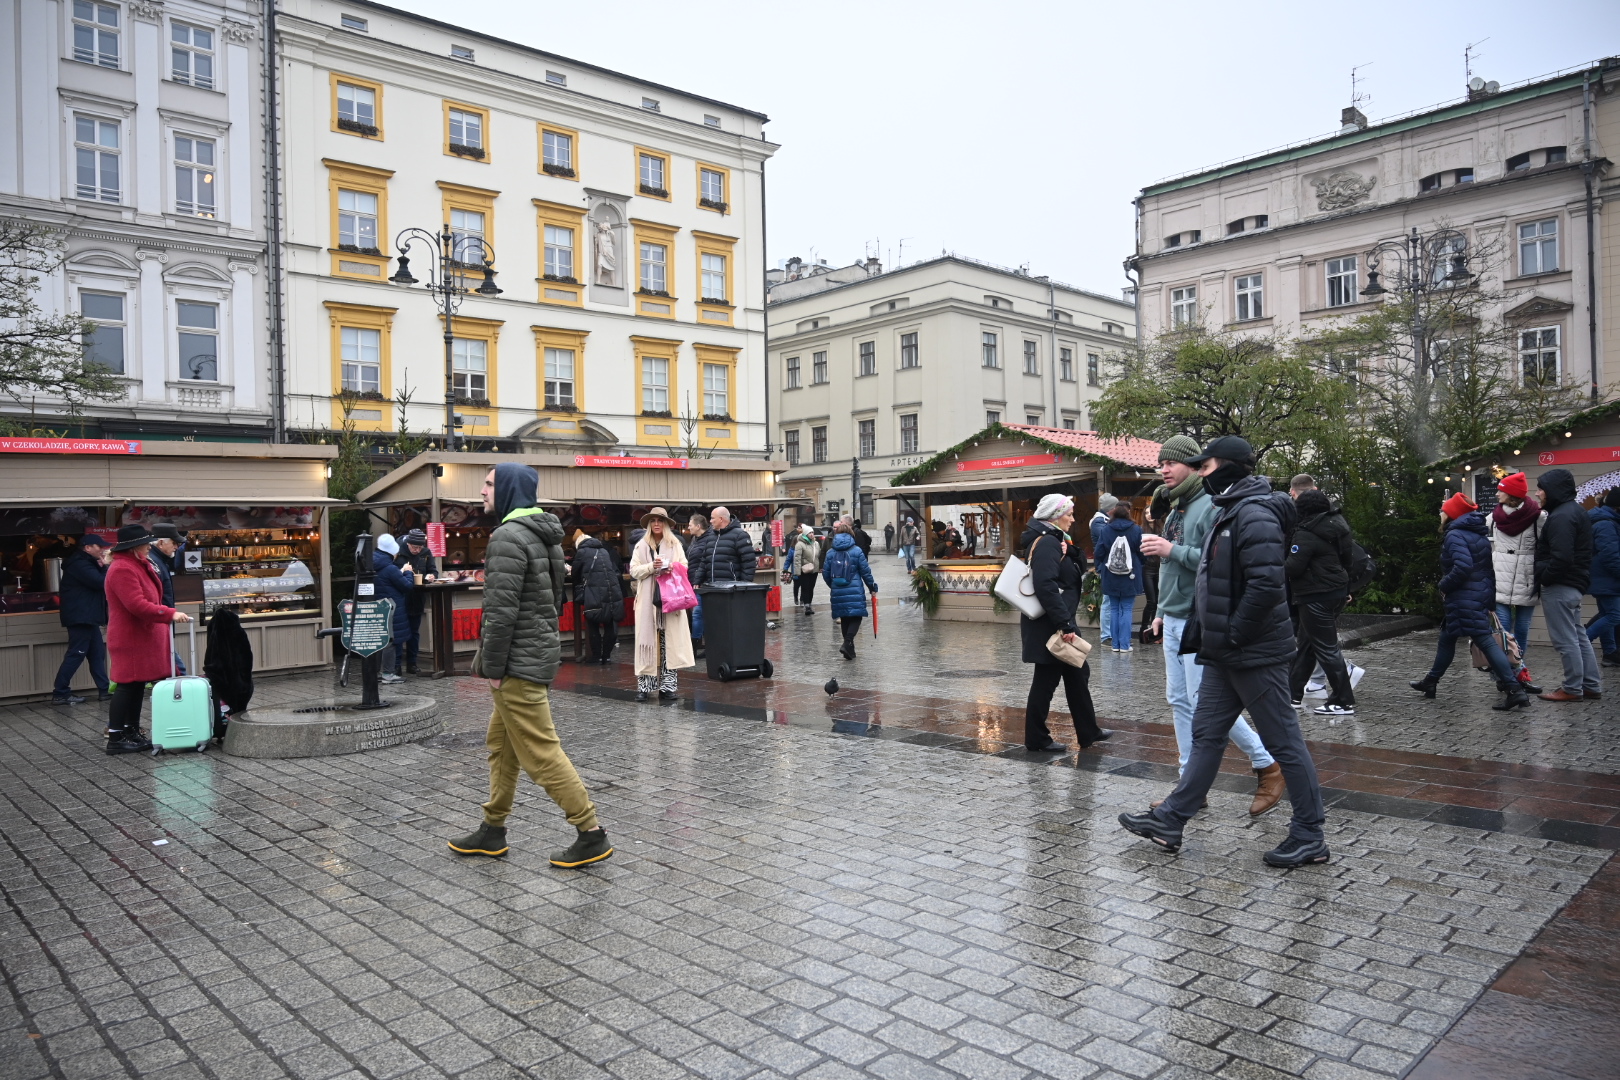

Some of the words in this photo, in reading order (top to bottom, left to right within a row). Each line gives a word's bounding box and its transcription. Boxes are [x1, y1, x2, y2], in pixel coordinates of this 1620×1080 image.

[890, 456, 924, 467] APTEKA
[326, 726, 334, 735] W
[336, 725, 352, 735] TYM
